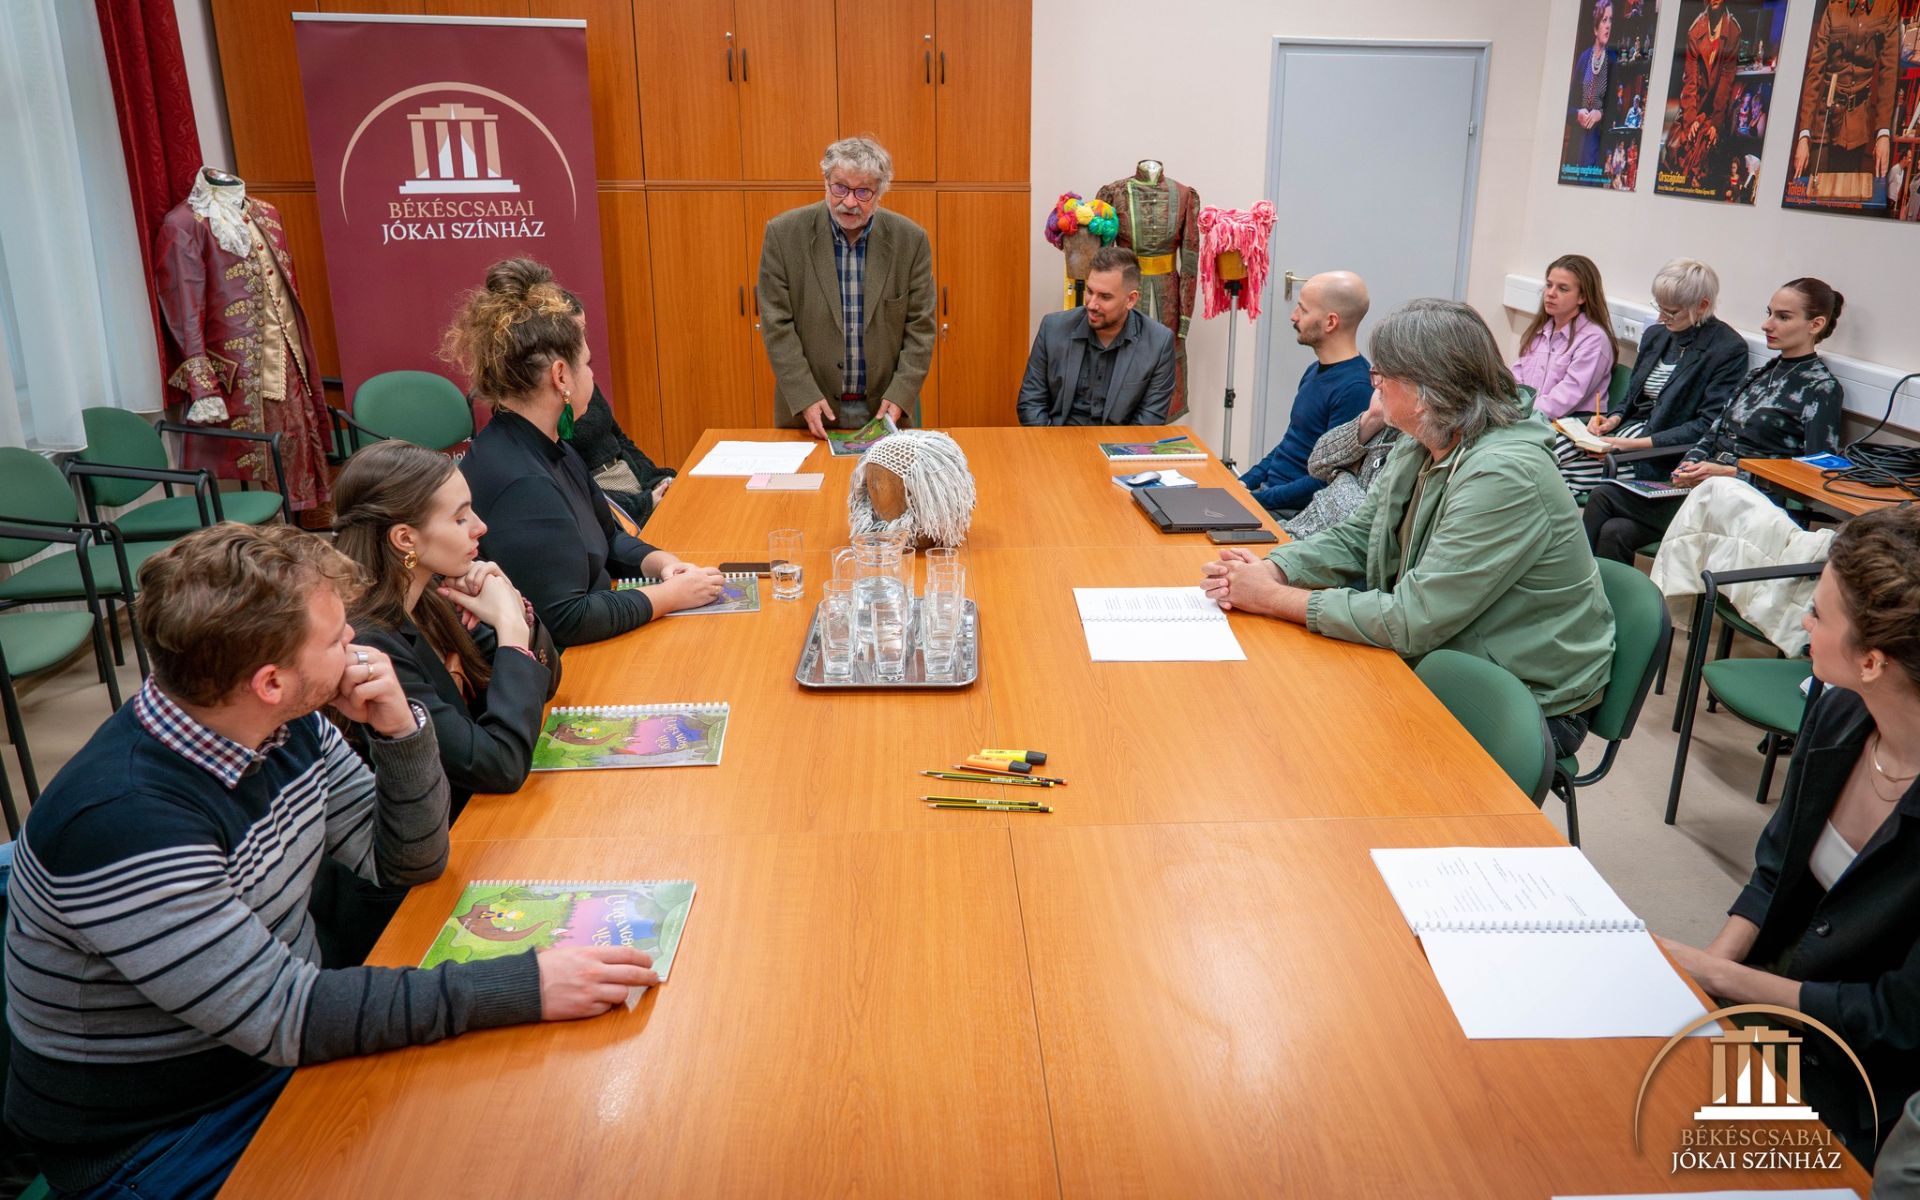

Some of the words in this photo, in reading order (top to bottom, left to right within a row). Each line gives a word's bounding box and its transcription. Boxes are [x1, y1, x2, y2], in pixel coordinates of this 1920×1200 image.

[388, 198, 536, 218] BÉKÉSCSABAI
[381, 219, 447, 245] JÓKAI
[450, 217, 546, 240] SZÍNHÁZ
